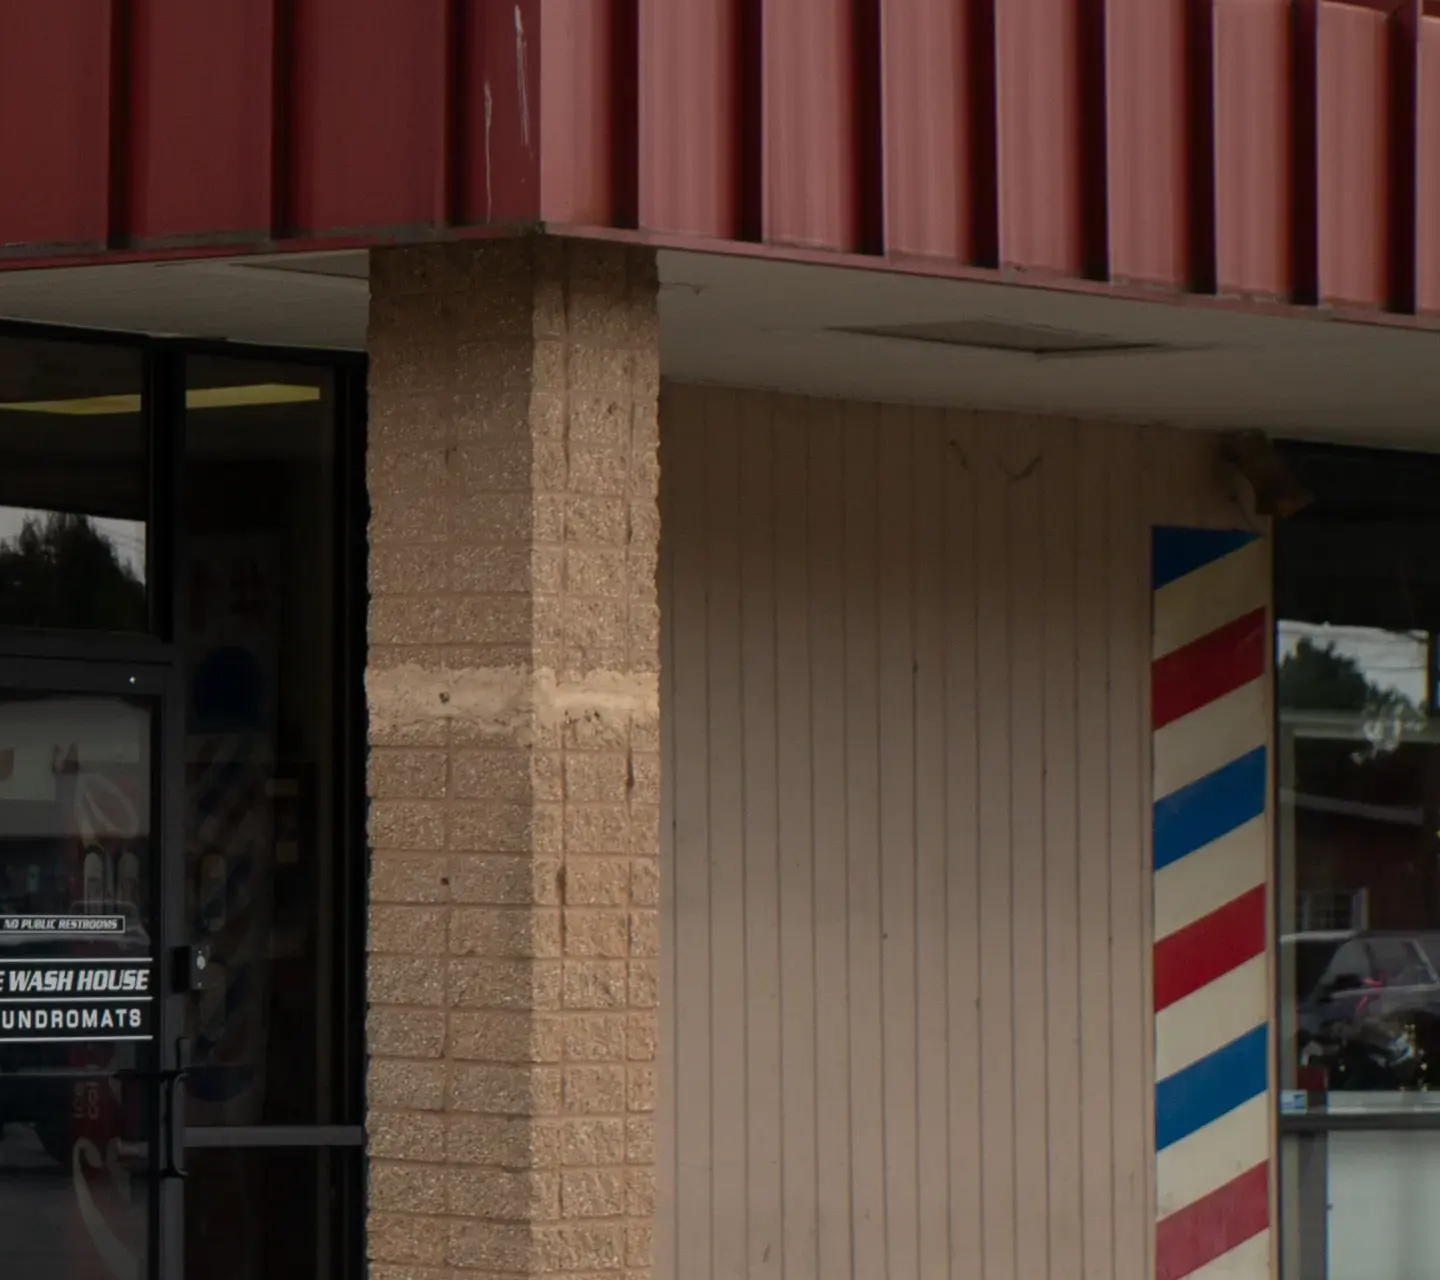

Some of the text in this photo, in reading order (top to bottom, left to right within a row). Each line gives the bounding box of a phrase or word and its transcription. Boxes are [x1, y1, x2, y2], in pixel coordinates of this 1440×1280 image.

[4, 919, 118, 930] NO PUBLIC RESTROOMS
[9, 970, 74, 992] WASH
[76, 969, 150, 991] HOUSE
